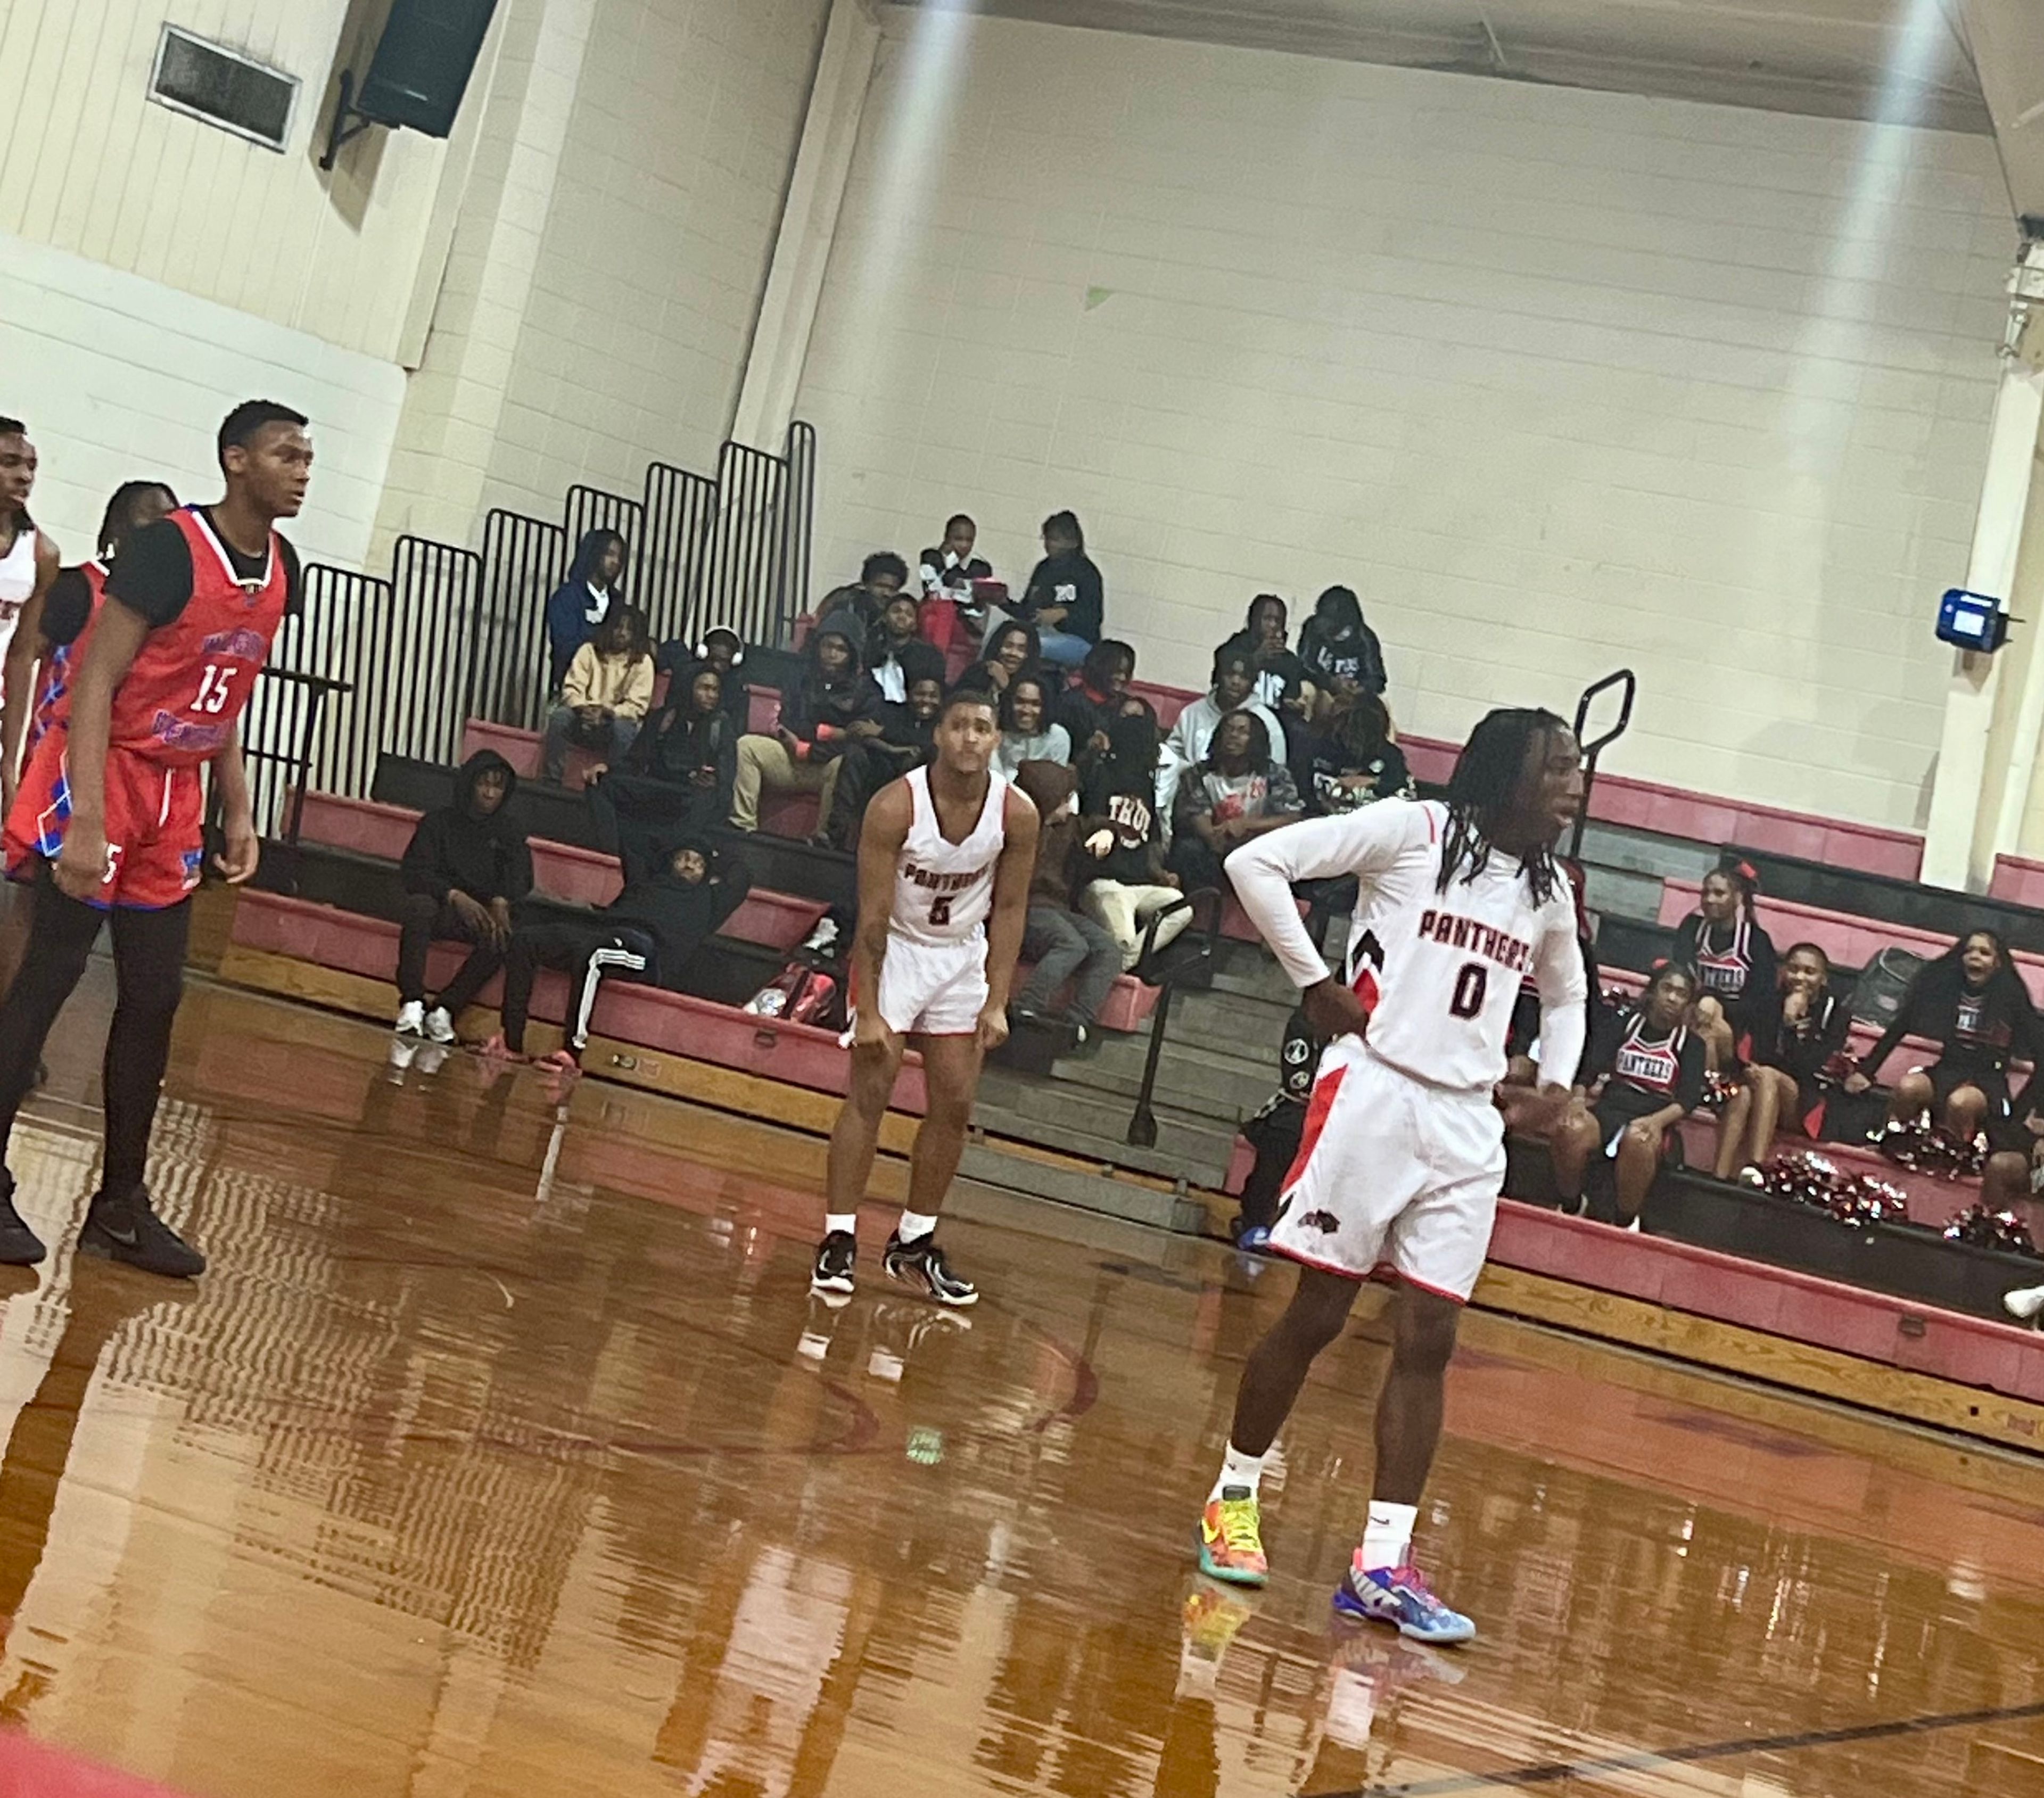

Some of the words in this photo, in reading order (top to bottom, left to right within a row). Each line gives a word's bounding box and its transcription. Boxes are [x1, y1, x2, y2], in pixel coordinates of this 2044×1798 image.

[190, 664, 238, 713] 15
[1417, 909, 1530, 971] PANTHERS
[1448, 961, 1488, 1021] 0
